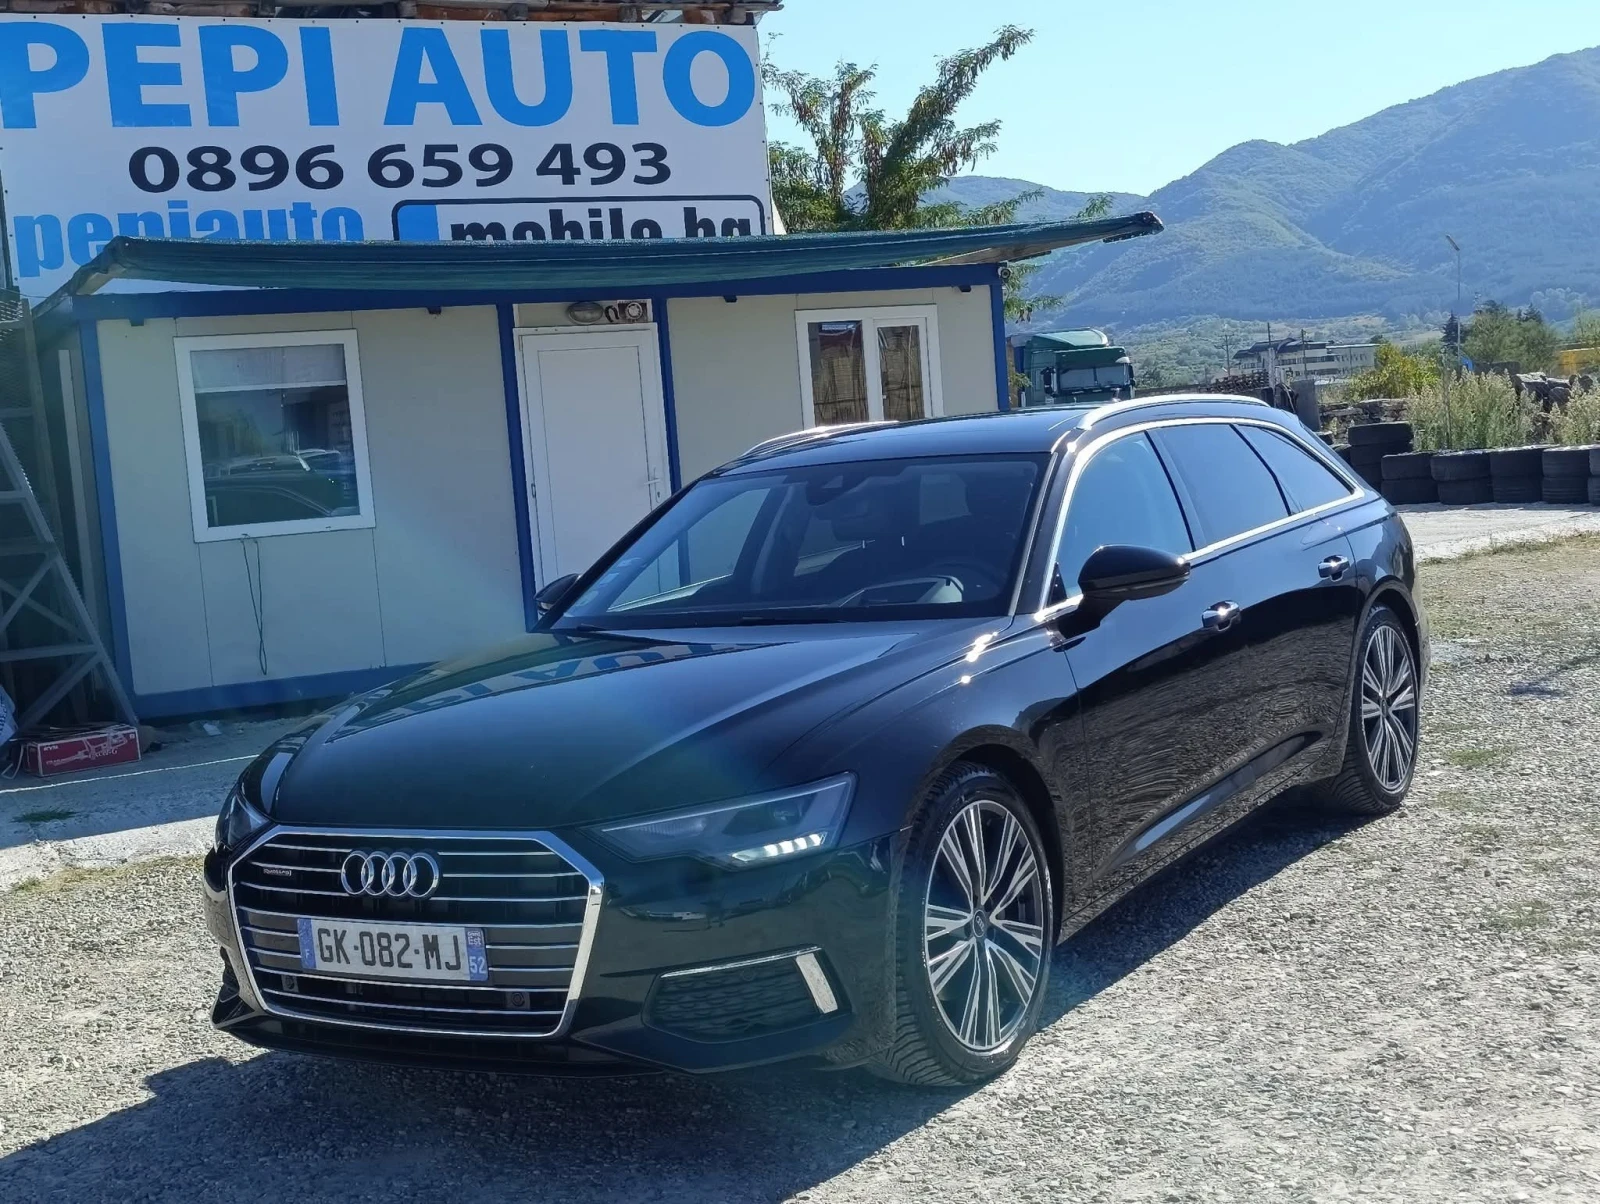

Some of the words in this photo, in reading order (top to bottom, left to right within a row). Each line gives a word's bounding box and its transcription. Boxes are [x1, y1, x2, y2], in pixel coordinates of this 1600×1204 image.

[0, 22, 340, 129] PEPI
[384, 26, 756, 128] AUTO
[128, 145, 344, 193] 0896
[367, 144, 513, 188] 659
[536, 143, 671, 186] 493
[317, 928, 461, 971] GK-082-MJ
[469, 956, 487, 974] 52
